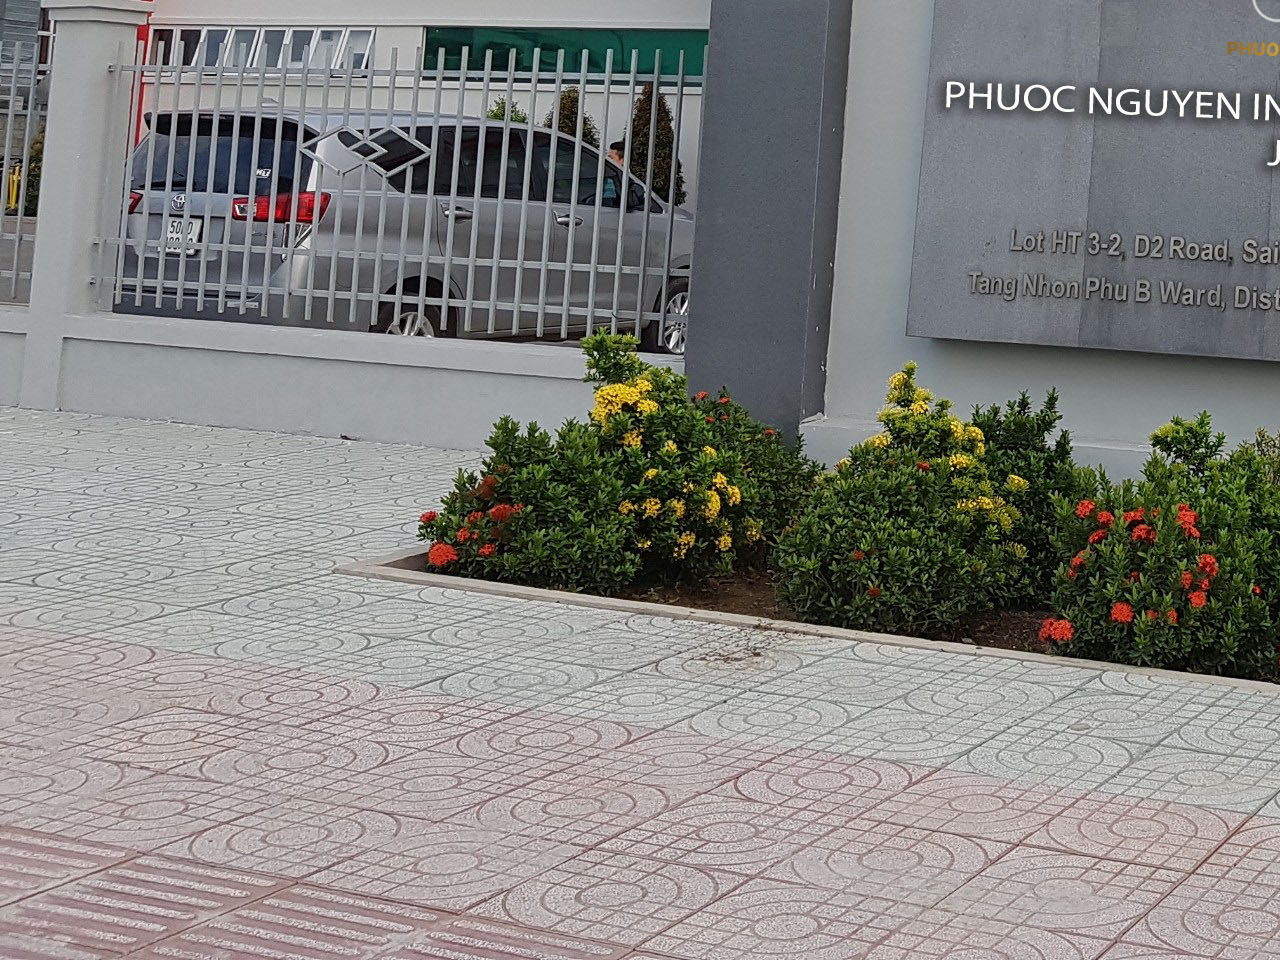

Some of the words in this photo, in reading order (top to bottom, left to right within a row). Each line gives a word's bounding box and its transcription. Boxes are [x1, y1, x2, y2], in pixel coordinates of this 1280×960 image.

[944, 80, 1077, 113] PHUOC
[1088, 87, 1242, 121] NGUYEN
[1010, 229, 1046, 253] Lot
[1051, 230, 1083, 255] HT
[1134, 234, 1165, 259] D2
[1168, 235, 1234, 265] Road,
[968, 270, 1019, 301] Tang
[1021, 273, 1080, 300] Nhon
[1085, 276, 1128, 302] Phu
[1135, 279, 1152, 303] B
[1159, 280, 1227, 313] Ward,
